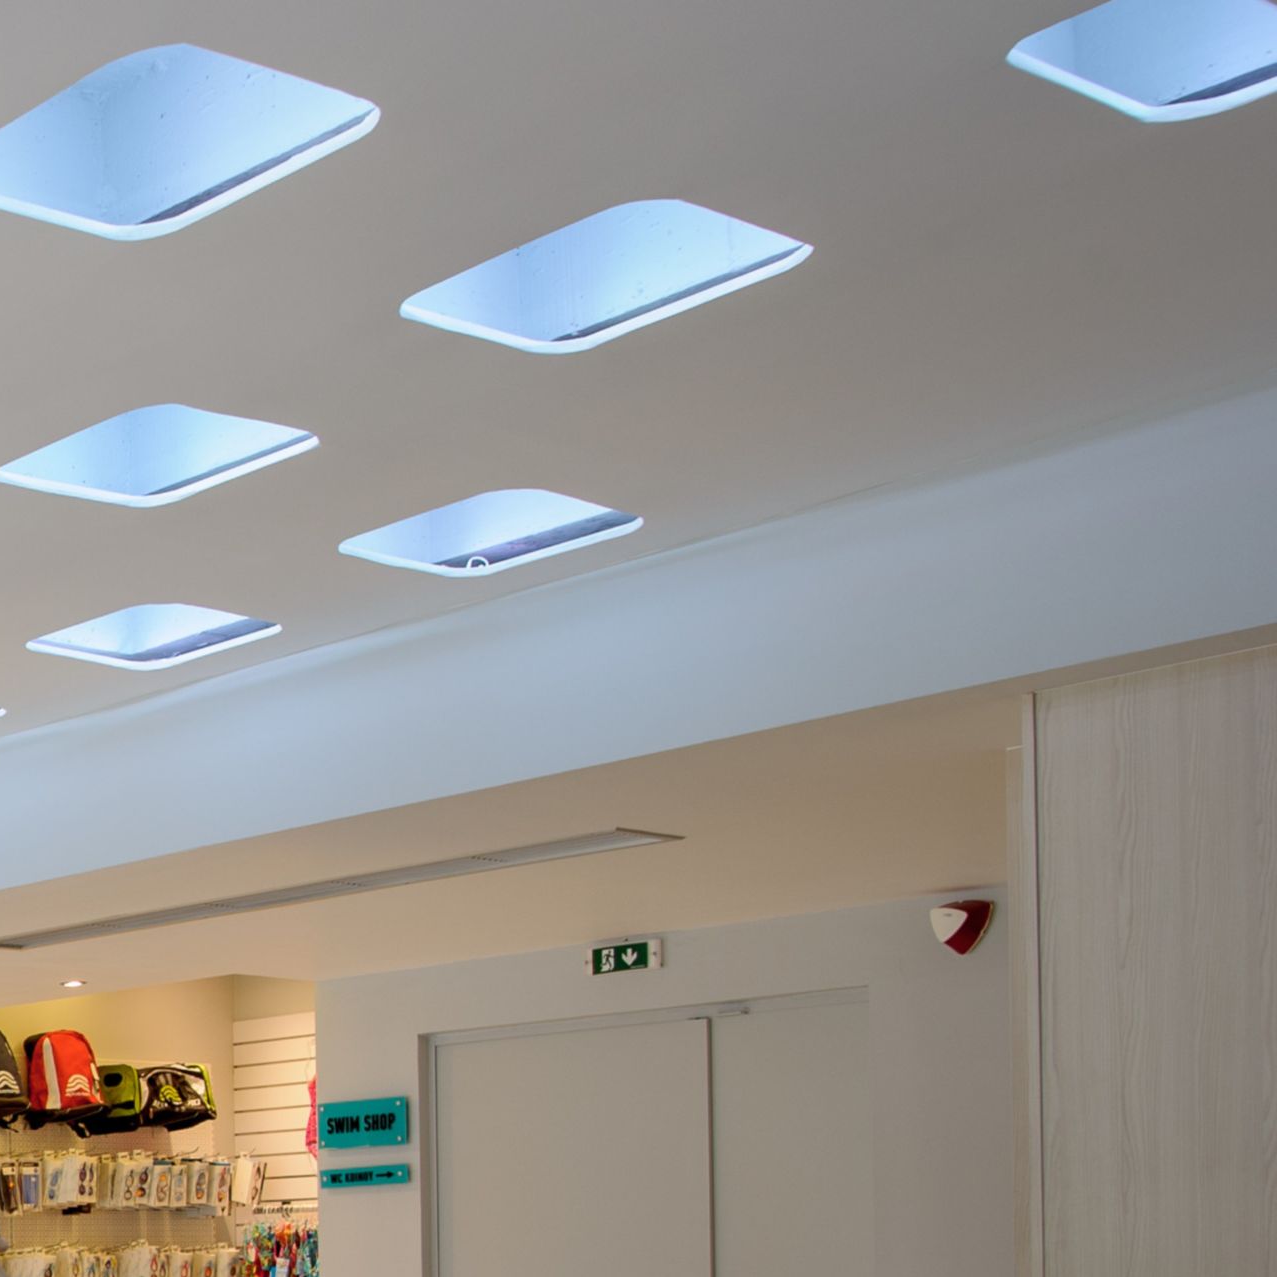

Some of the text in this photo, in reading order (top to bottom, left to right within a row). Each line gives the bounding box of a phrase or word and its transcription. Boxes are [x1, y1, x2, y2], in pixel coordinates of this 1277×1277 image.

[327, 1112, 396, 1135] SWIM SHOP
[330, 1173, 343, 1184] WC
